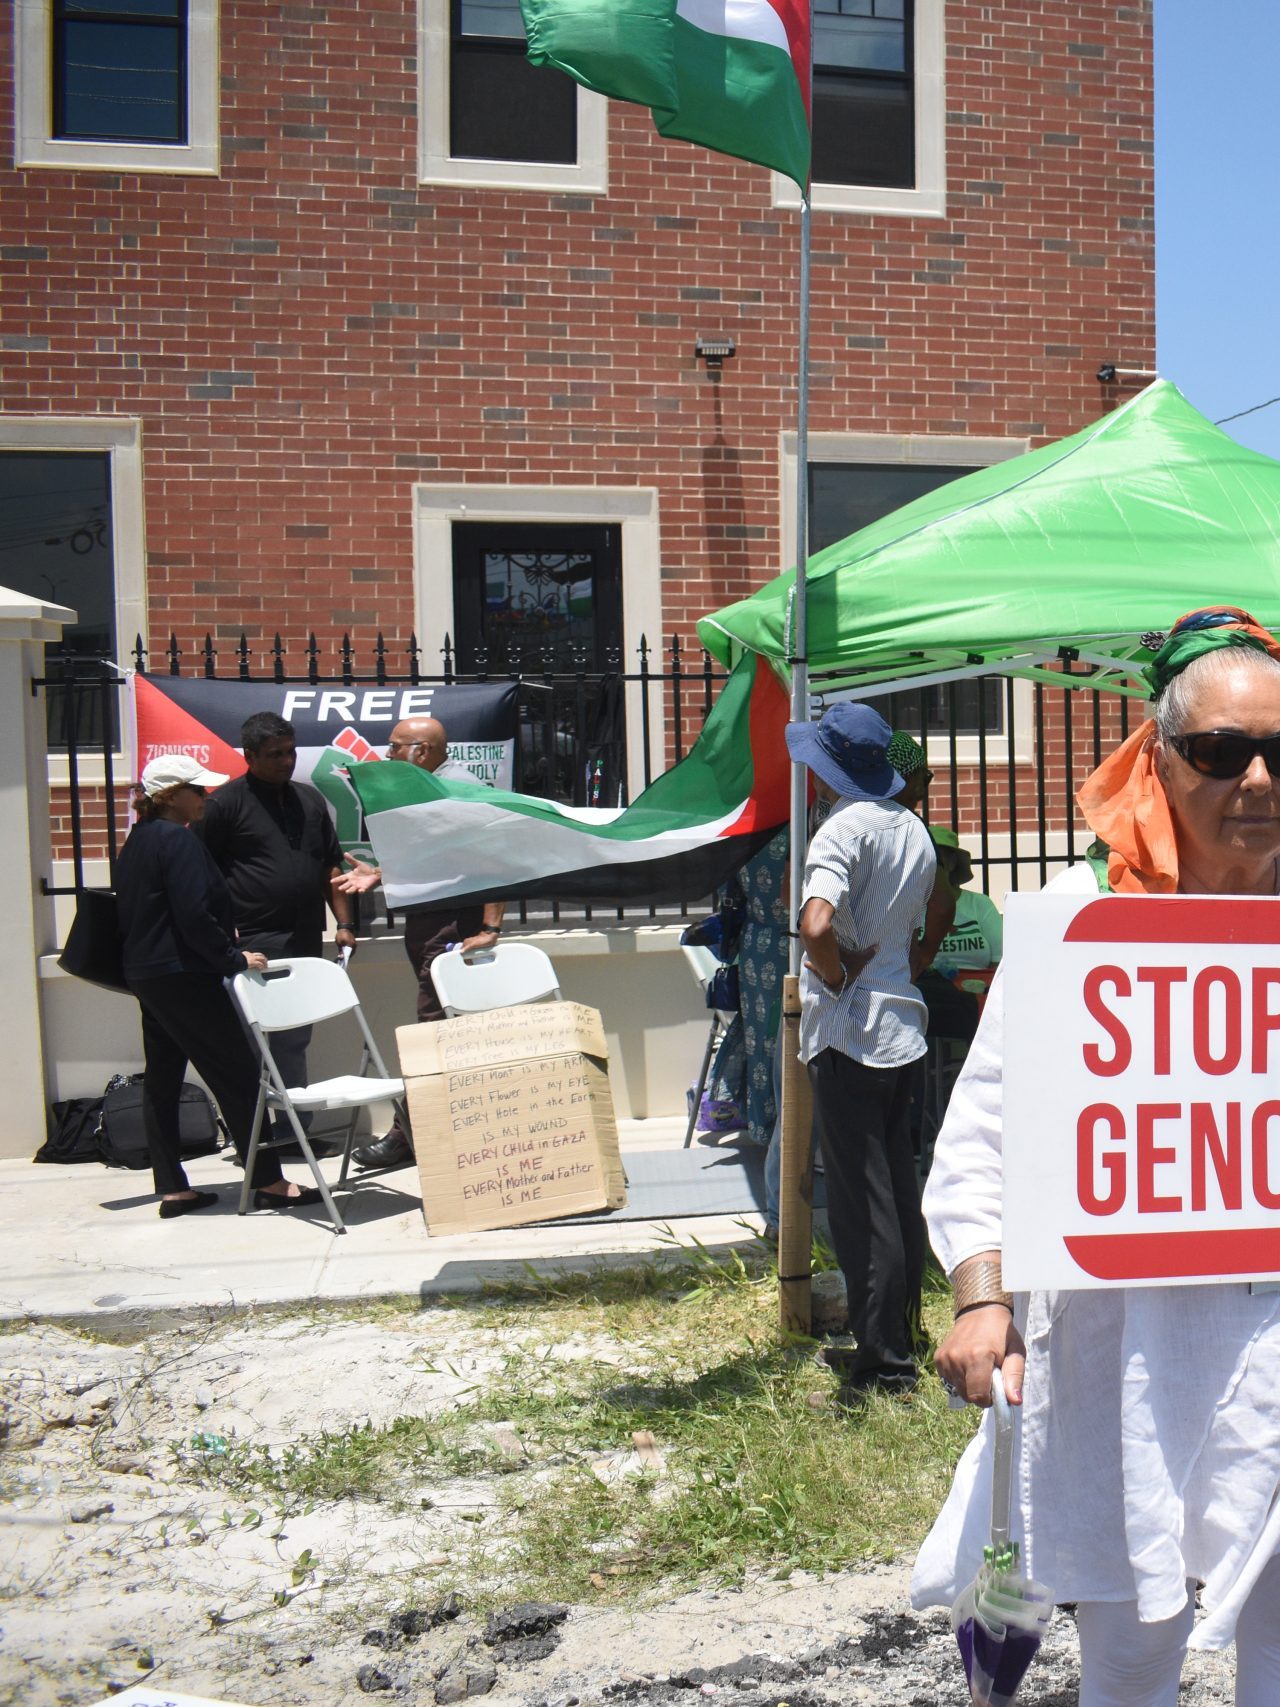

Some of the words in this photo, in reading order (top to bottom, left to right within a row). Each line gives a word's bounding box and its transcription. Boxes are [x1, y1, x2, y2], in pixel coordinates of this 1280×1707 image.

[282, 690, 434, 721] FREE
[146, 744, 210, 763] ZIONISTS
[437, 1026, 482, 1043] EVERY
[577, 1015, 594, 1026] ME
[445, 1042, 480, 1059] EVERY
[449, 1074, 484, 1093] EVERY
[450, 1094, 484, 1114] EVERY
[488, 1088, 521, 1102] Flower
[569, 1075, 590, 1088] EYE
[453, 1112, 488, 1131] EVERY
[496, 1107, 518, 1120] Hole
[529, 1103, 539, 1111] in
[546, 1098, 564, 1106] the
[482, 1132, 495, 1144] IS
[528, 1118, 568, 1134] WOUND
[457, 1145, 498, 1169] EVERY
[538, 1140, 548, 1149] in
[552, 1130, 586, 1147] GAZA
[463, 1179, 503, 1199] EVERY
[506, 1175, 538, 1190] Mother
[542, 1171, 555, 1182] and
[558, 1162, 594, 1179] Father
[496, 1164, 509, 1177] IS
[520, 1157, 544, 1172] ME
[502, 1194, 513, 1206] IS
[521, 1187, 543, 1201] ME
